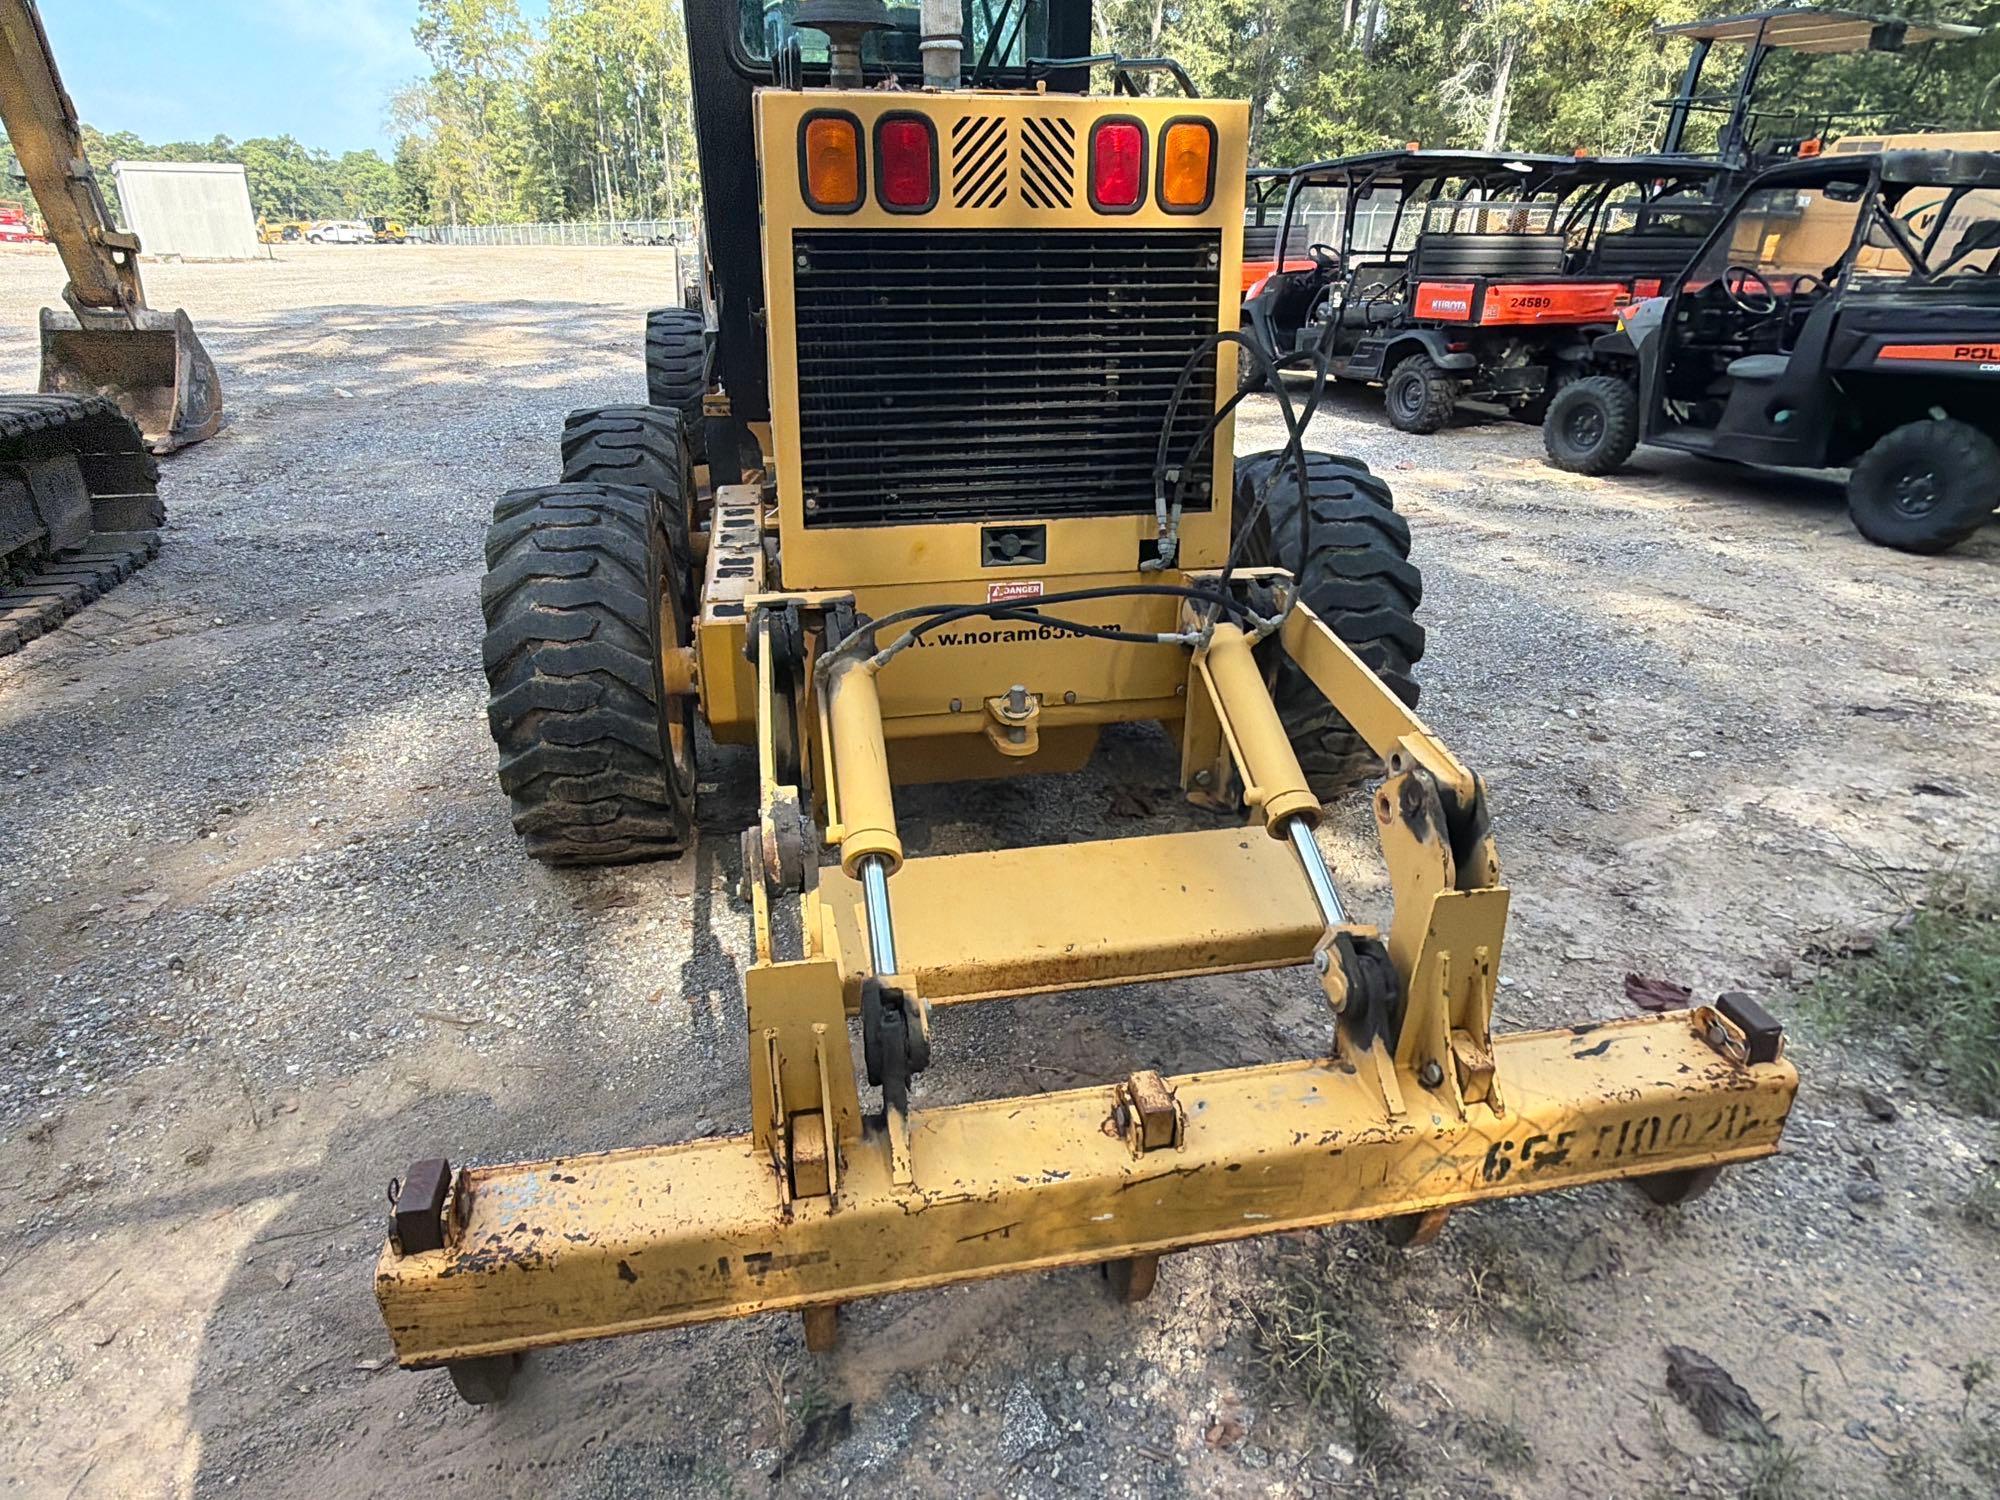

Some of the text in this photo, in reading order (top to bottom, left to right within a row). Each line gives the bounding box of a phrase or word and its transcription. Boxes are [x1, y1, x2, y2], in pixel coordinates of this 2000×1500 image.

[1432, 300, 1467, 311] KUBOTA
[1510, 297, 1551, 308] 24589
[1954, 347, 2000, 360] POL
[1003, 585, 1040, 595] DANGER
